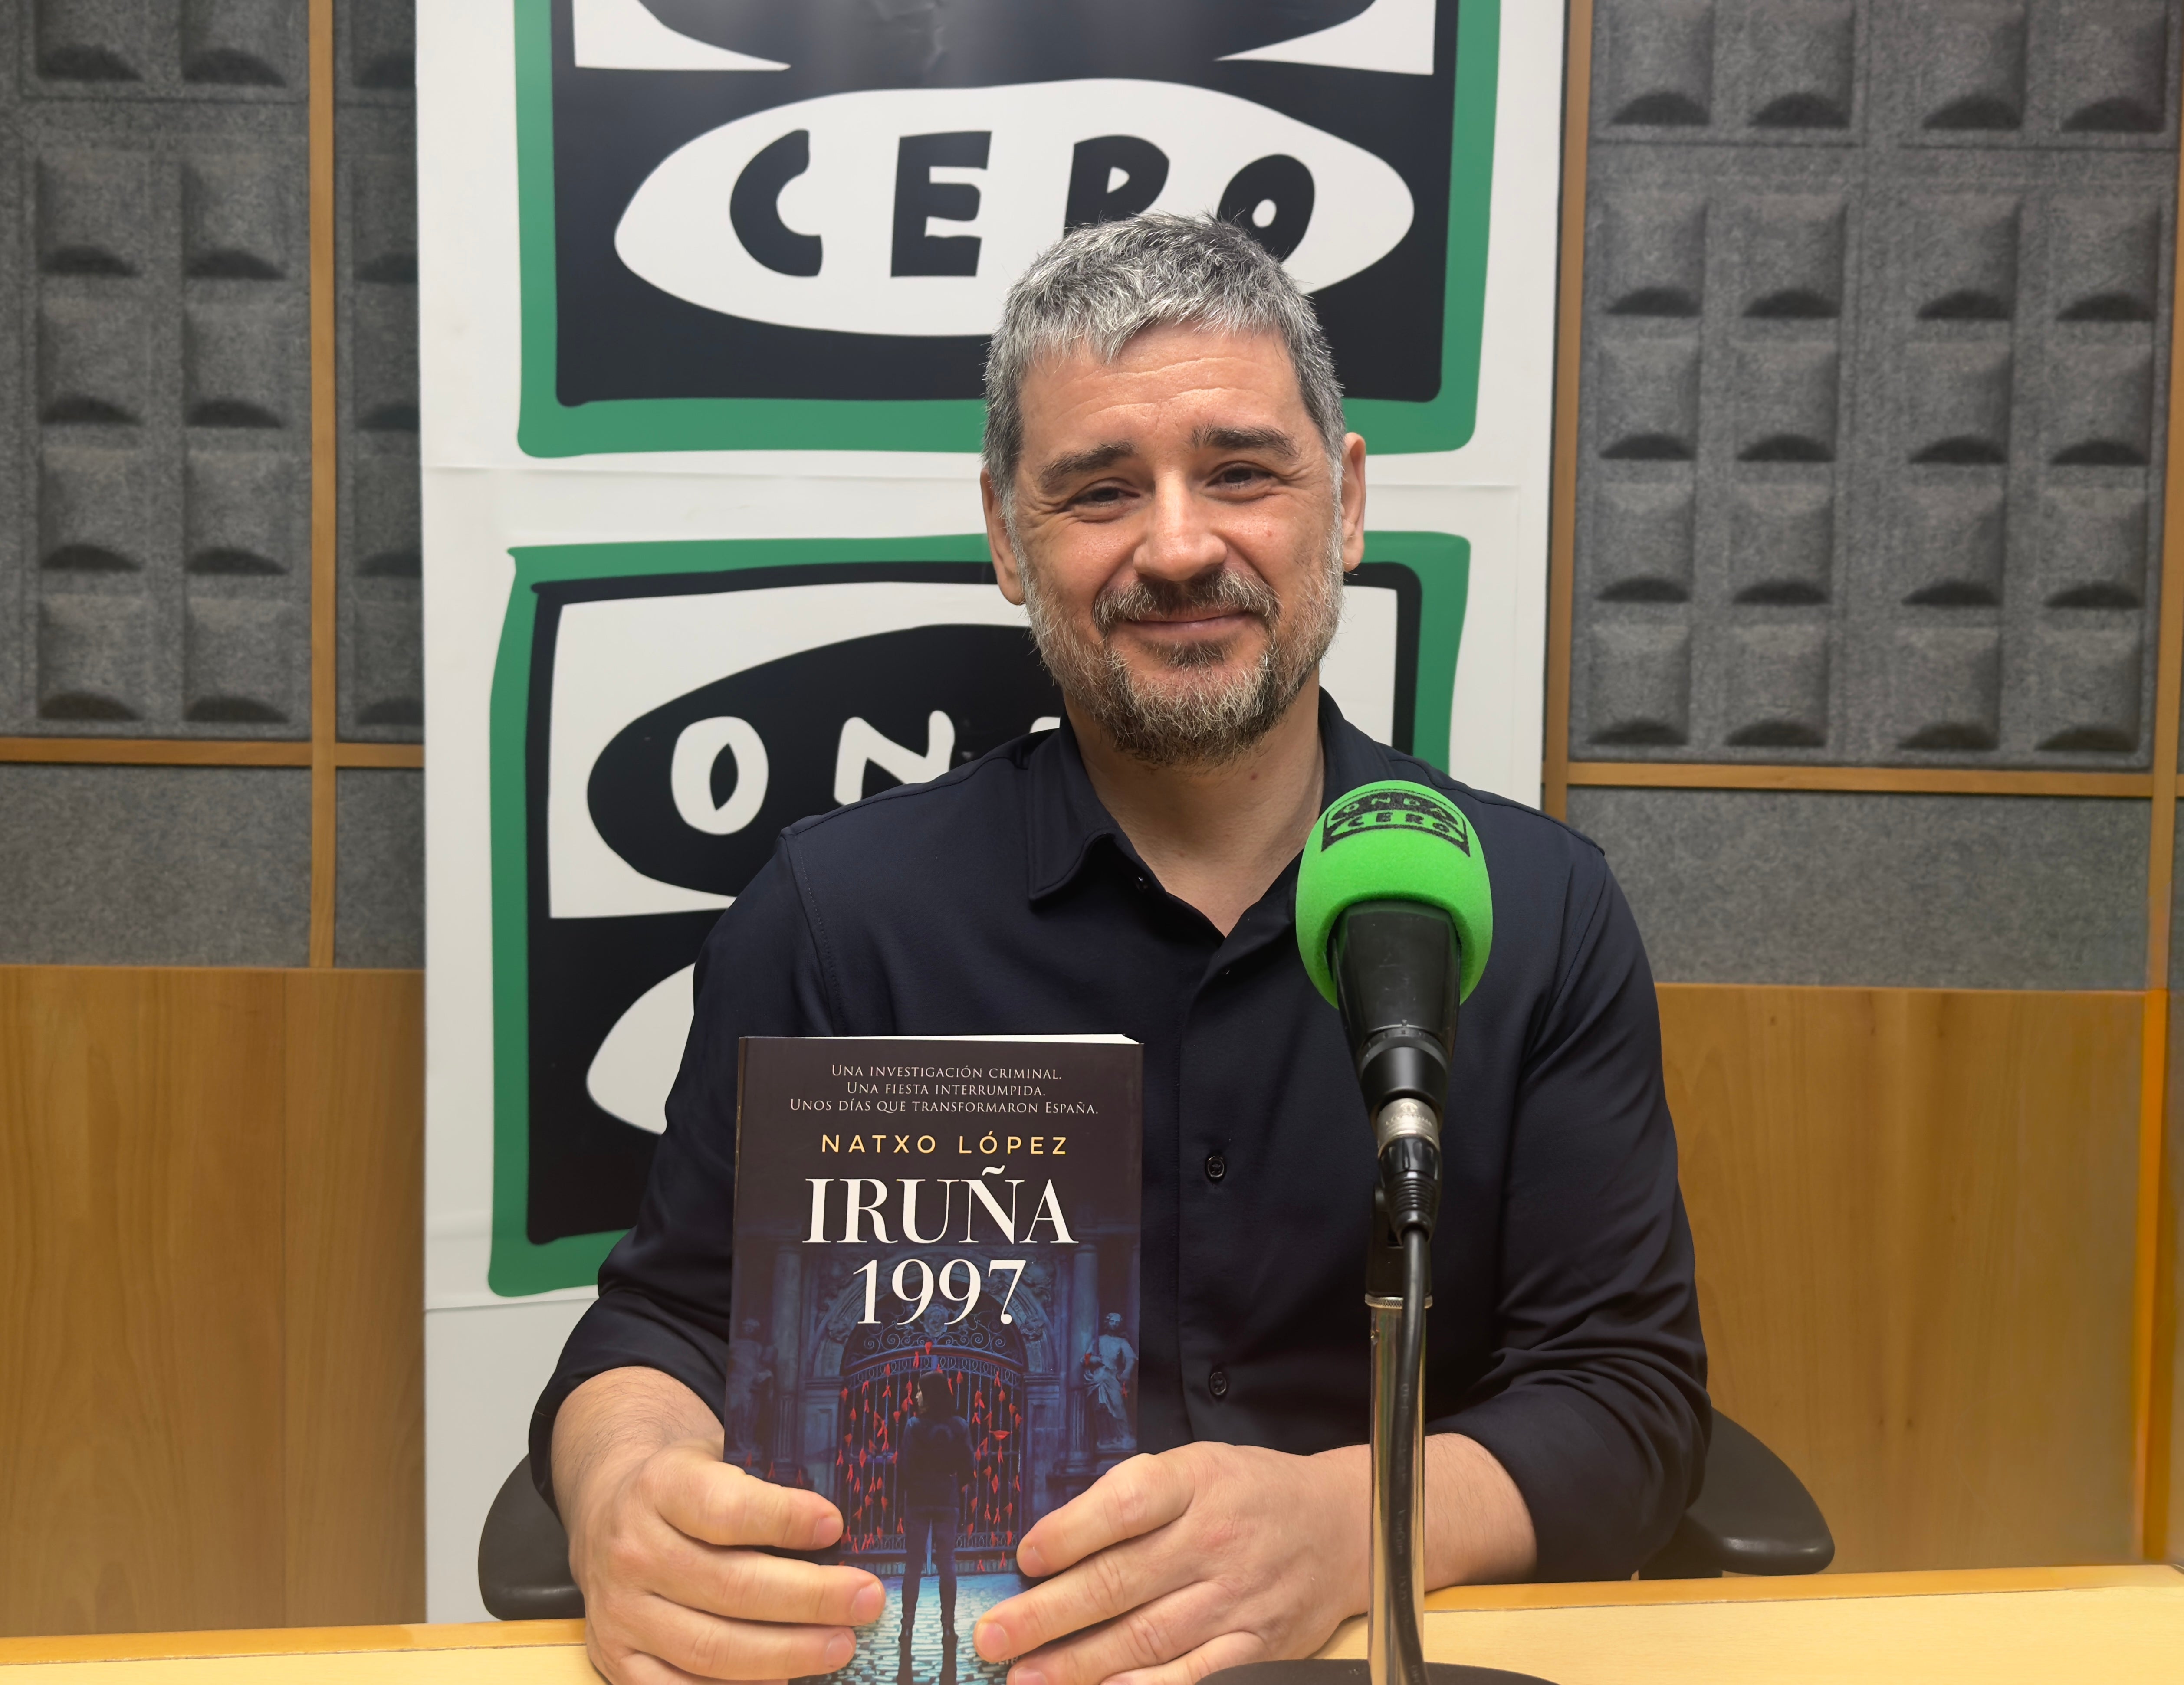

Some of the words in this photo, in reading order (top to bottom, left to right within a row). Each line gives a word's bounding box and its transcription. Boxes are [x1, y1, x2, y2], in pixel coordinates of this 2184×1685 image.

[1343, 797, 1447, 818] ONDA
[1347, 812, 1450, 833] CERO
[832, 1064, 863, 1076] UNA
[870, 1065, 982, 1078] INVESTIGACIÓN
[989, 1068, 1061, 1079] CRIMINAL.
[847, 1082, 878, 1094] UNA
[886, 1084, 929, 1095] FIESTA
[936, 1085, 1045, 1096] INTERRUMPIDA.
[791, 1098, 831, 1111] UNOS
[839, 1098, 870, 1111] DÍAS
[877, 1101, 906, 1114] QUE
[912, 1101, 1038, 1113] TRANSFORMARON
[1045, 1101, 1098, 1114] ESPAÑA.
[822, 1134, 936, 1154] NATXO
[959, 1131, 1067, 1154] LÓPEZ
[802, 1165, 1079, 1244] IRUÑA
[853, 1259, 1026, 1325] 1997
